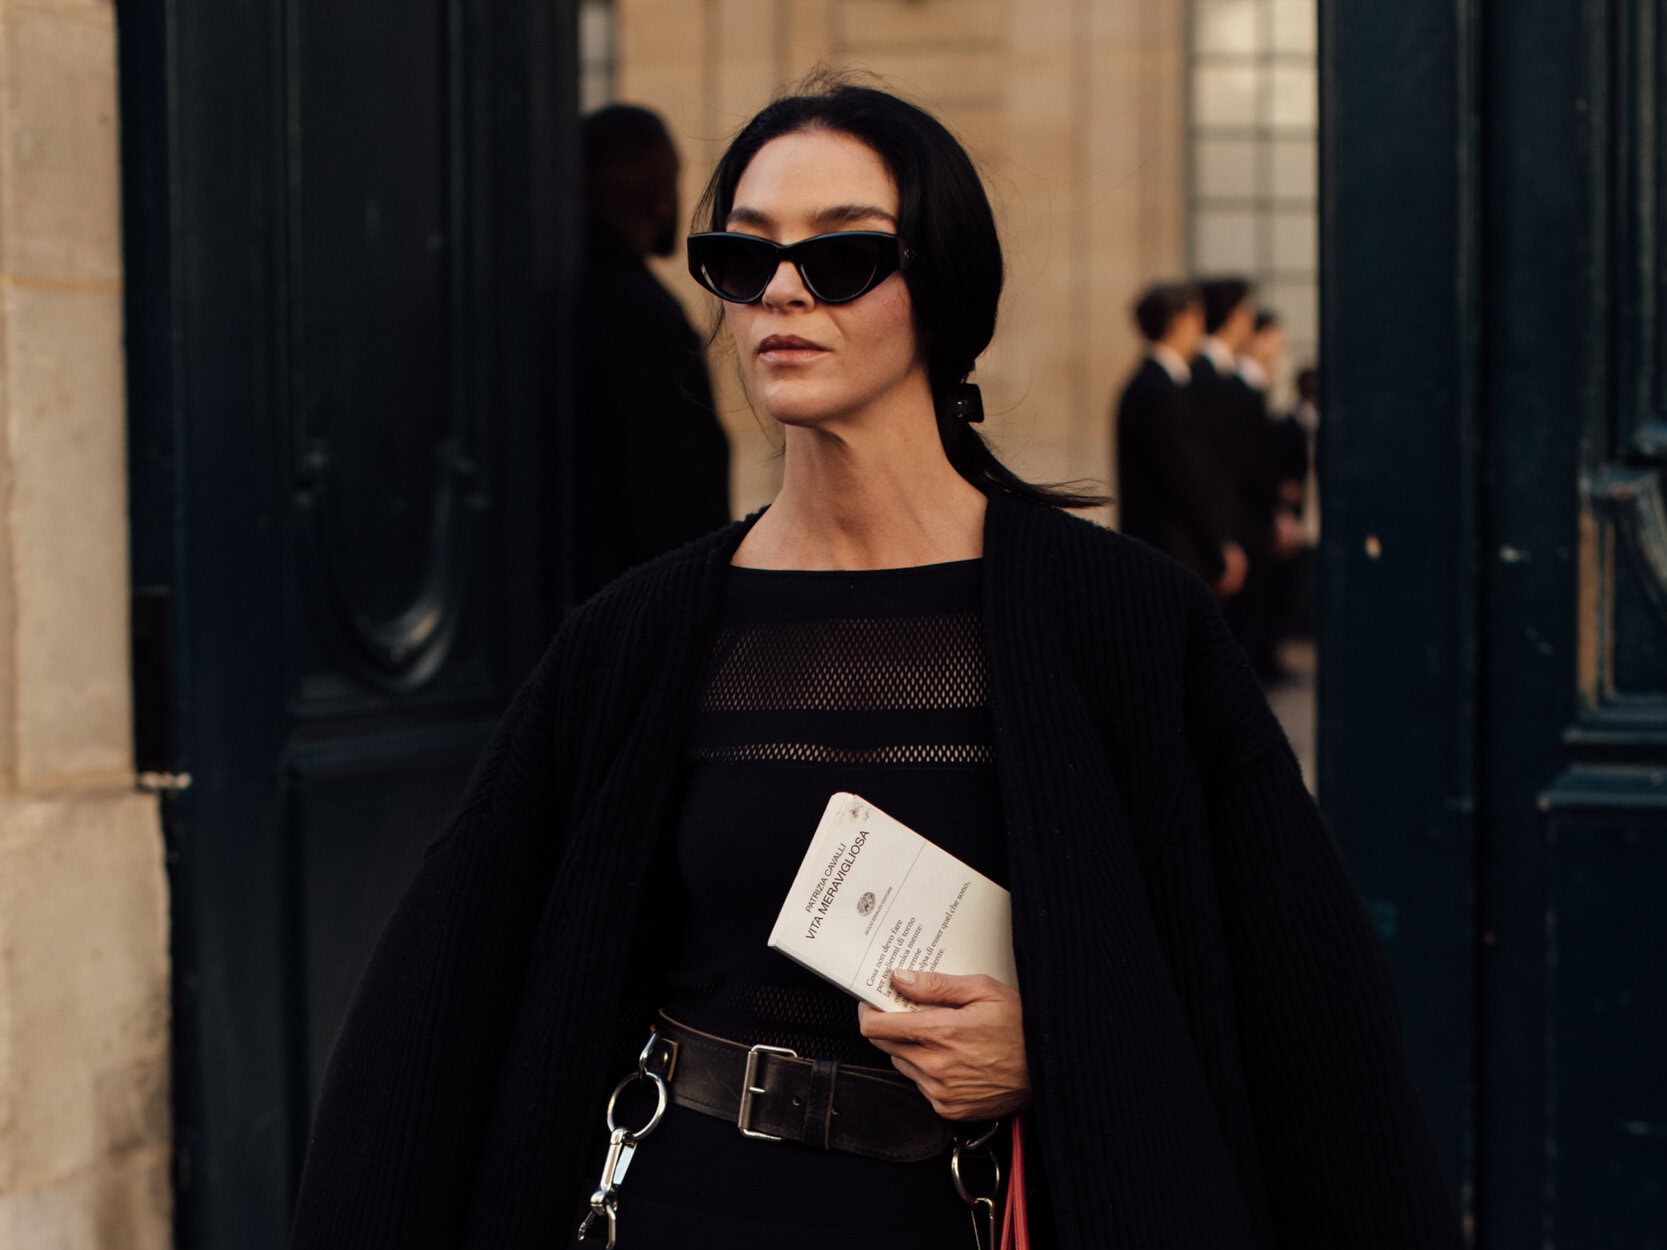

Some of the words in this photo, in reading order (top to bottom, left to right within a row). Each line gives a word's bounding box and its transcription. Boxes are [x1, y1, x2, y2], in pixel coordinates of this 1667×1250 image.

[805, 877, 828, 913] PATRIZIA
[824, 843, 847, 877] CAVALLI
[805, 916, 824, 940] VITA
[818, 830, 870, 915] MERAVIGLIOSA
[866, 968, 879, 987] Cosa
[876, 953, 886, 968] non
[882, 935, 895, 953] devo
[890, 919, 903, 935] fare
[876, 979, 885, 994] per
[882, 945, 901, 980] togliermi
[896, 936, 904, 947] di
[902, 917, 916, 937] torno
[898, 949, 910, 968] mica
[919, 955, 930, 972] olpa
[926, 946, 934, 956] di
[931, 929, 943, 947] esser
[941, 912, 952, 930] quel
[949, 899, 960, 914] che
[957, 881, 971, 900] sono,
